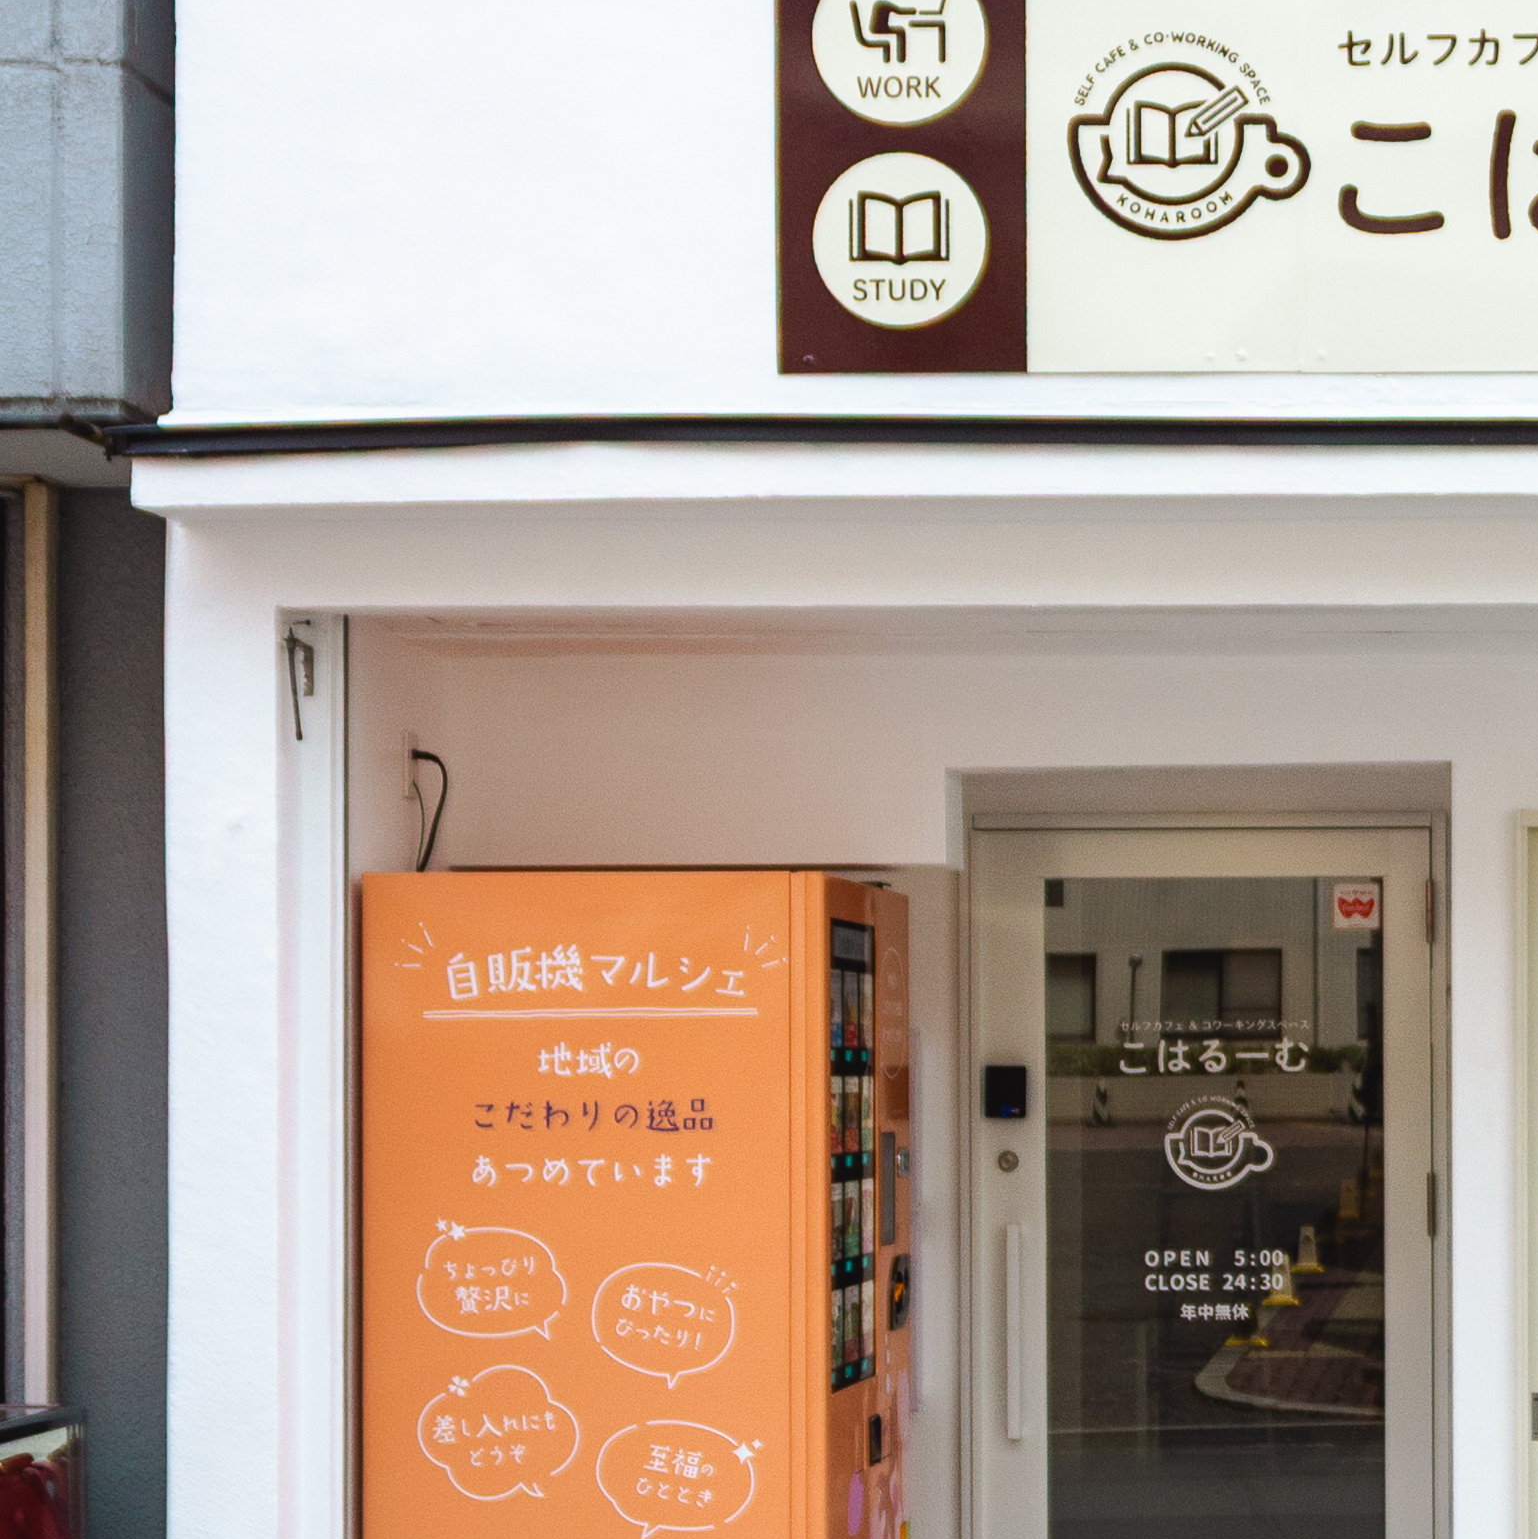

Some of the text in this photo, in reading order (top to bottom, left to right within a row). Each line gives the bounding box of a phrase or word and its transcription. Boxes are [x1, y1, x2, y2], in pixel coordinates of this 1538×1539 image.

[857, 75, 941, 99] WORK
[1074, 73, 1095, 107] SELF
[1095, 45, 1127, 74] CAFE
[1128, 38, 1140, 52] &
[1239, 63, 1272, 106] SPACE
[1116, 190, 1233, 223] KOHAROOM
[852, 277, 947, 302] STUDY
[446, 944, 746, 1001] 自販機マルシェ
[537, 1041, 640, 1079] 地域の
[1119, 1036, 1309, 1074] こはるーむ
[474, 1098, 714, 1133] こだわりの逸品
[471, 1153, 712, 1188] あつめています
[442, 1256, 536, 1281] ちょっぴり
[1144, 1249, 1284, 1267] OPEN 5:00
[1144, 1273, 1284, 1291] CLOSE 24:30
[455, 1285, 530, 1315] 贅沢に
[621, 1283, 715, 1323] おやつに
[1180, 1303, 1250, 1321] 年中無休
[433, 1410, 556, 1444] 差し入れにも
[469, 1443, 526, 1467] どうぞ
[642, 1444, 715, 1479] 至福の
[635, 1477, 712, 1508] ひととき
